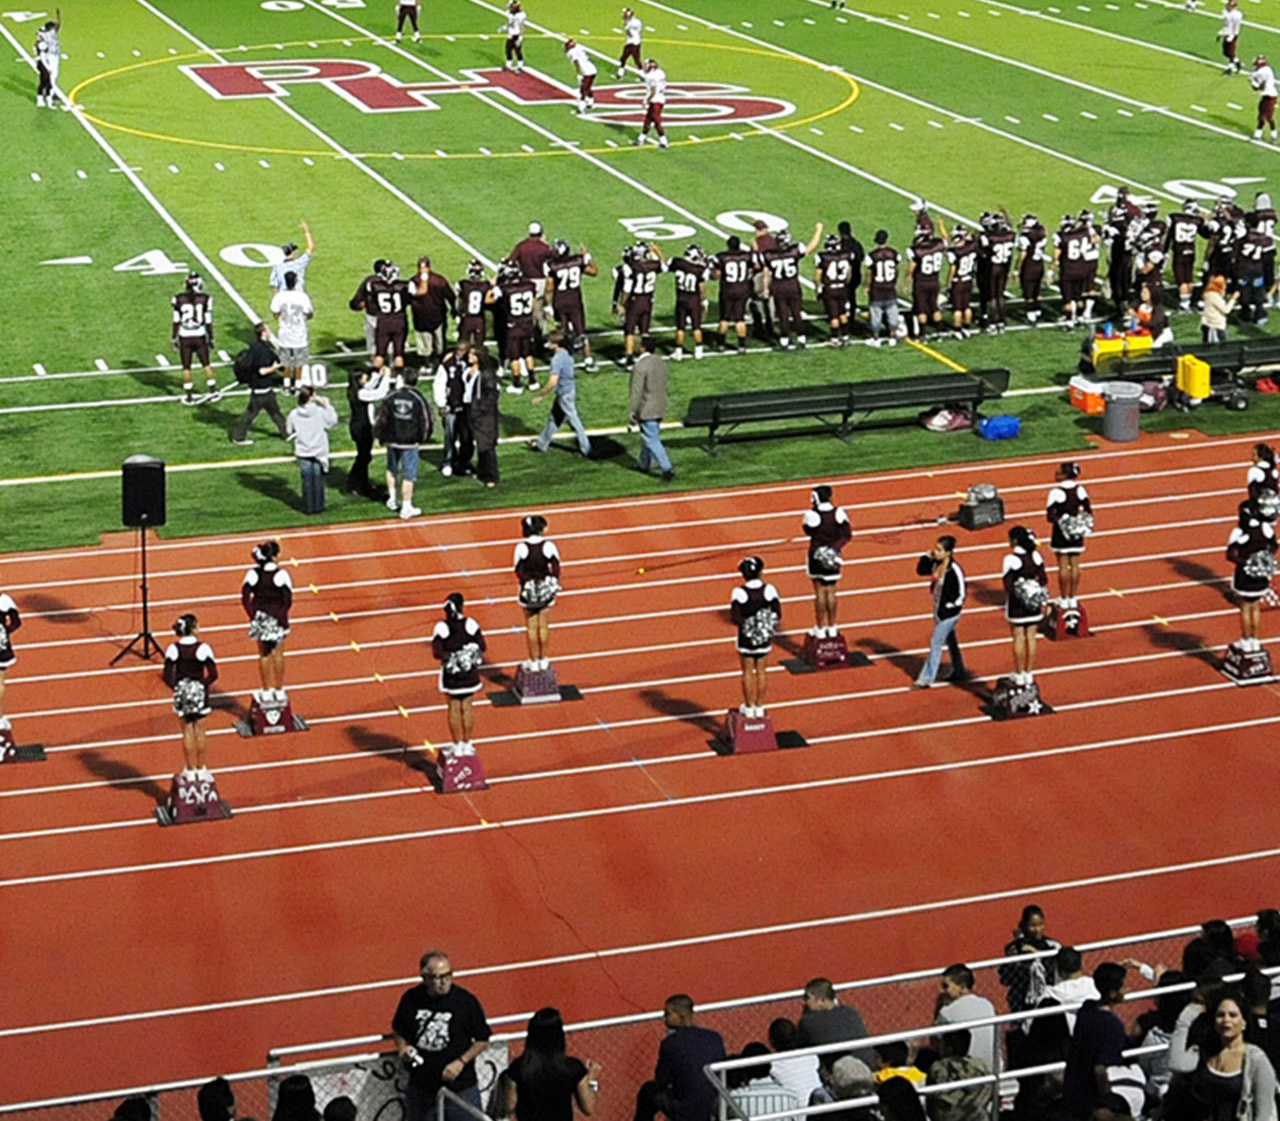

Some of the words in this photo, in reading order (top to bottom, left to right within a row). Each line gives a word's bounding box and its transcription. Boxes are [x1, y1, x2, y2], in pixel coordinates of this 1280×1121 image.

[179, 58, 798, 127] PHS
[618, 210, 790, 241] 50
[113, 243, 285, 276] 40
[770, 257, 798, 280] 75
[826, 259, 851, 282] 43
[874, 260, 897, 283] 16
[921, 252, 943, 276] 68
[556, 265, 582, 291] 79
[633, 270, 657, 294] 12
[725, 260, 748, 284] 91
[377, 291, 402, 314] 51
[467, 290, 483, 315] 8
[509, 290, 535, 316] 53
[181, 303, 205, 327] 21
